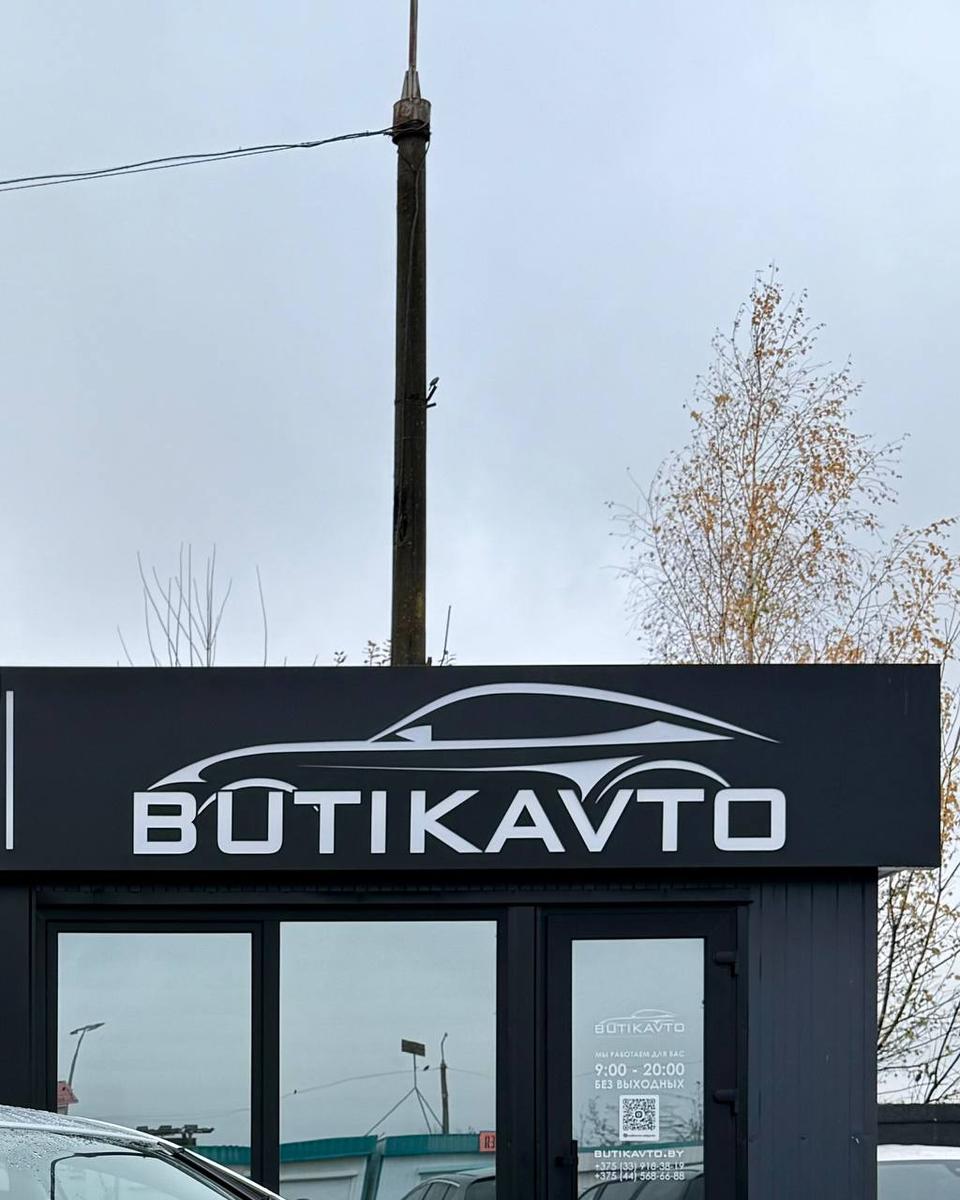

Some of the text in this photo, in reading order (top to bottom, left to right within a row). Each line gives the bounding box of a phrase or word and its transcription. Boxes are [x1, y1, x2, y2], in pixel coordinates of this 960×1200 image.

[132, 787, 786, 855] BUTIKAVTO
[594, 1023, 685, 1034] BUTIKAVTO
[595, 1063, 627, 1077] 9:00
[643, 1062, 685, 1076] 20:00
[595, 1079, 685, 1090] БЕЗ ВЫХОДНЫХ
[594, 1149, 685, 1159] BUTIKAVTO.BY
[595, 1162, 617, 1172] +375
[620, 1161, 637, 1173] (33)
[595, 1171, 685, 1182] +375 (44) 568-66-88
